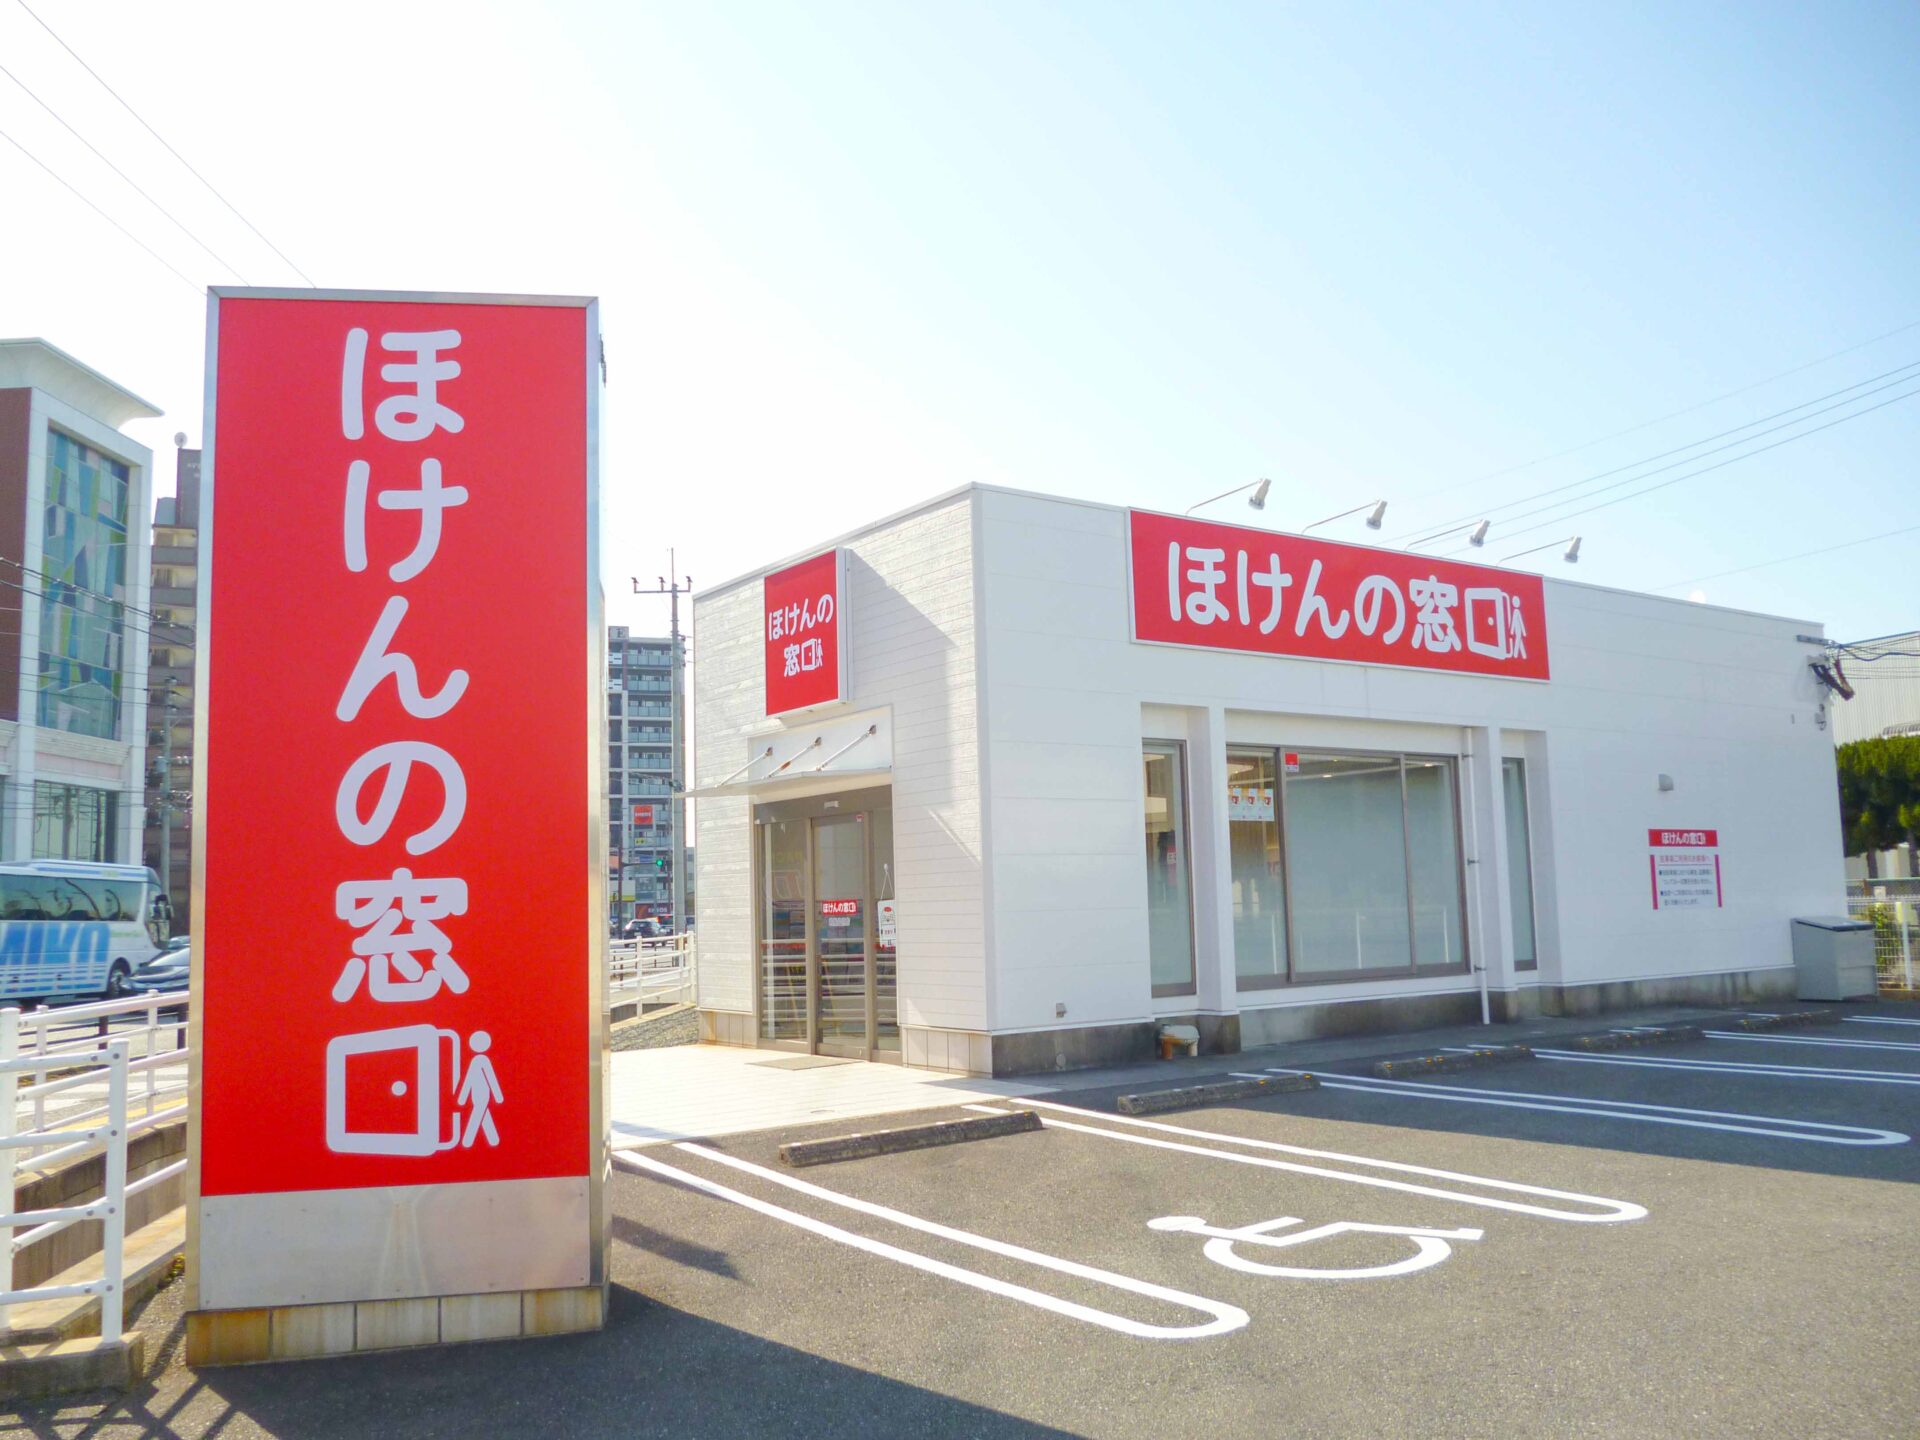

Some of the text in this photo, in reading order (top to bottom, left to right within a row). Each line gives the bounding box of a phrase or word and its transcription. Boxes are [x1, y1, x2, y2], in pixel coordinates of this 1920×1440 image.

[768, 593, 834, 641] ほけんの
[1168, 541, 1510, 660] ほけんの窓口
[326, 326, 471, 1157] ほけんの窓口
